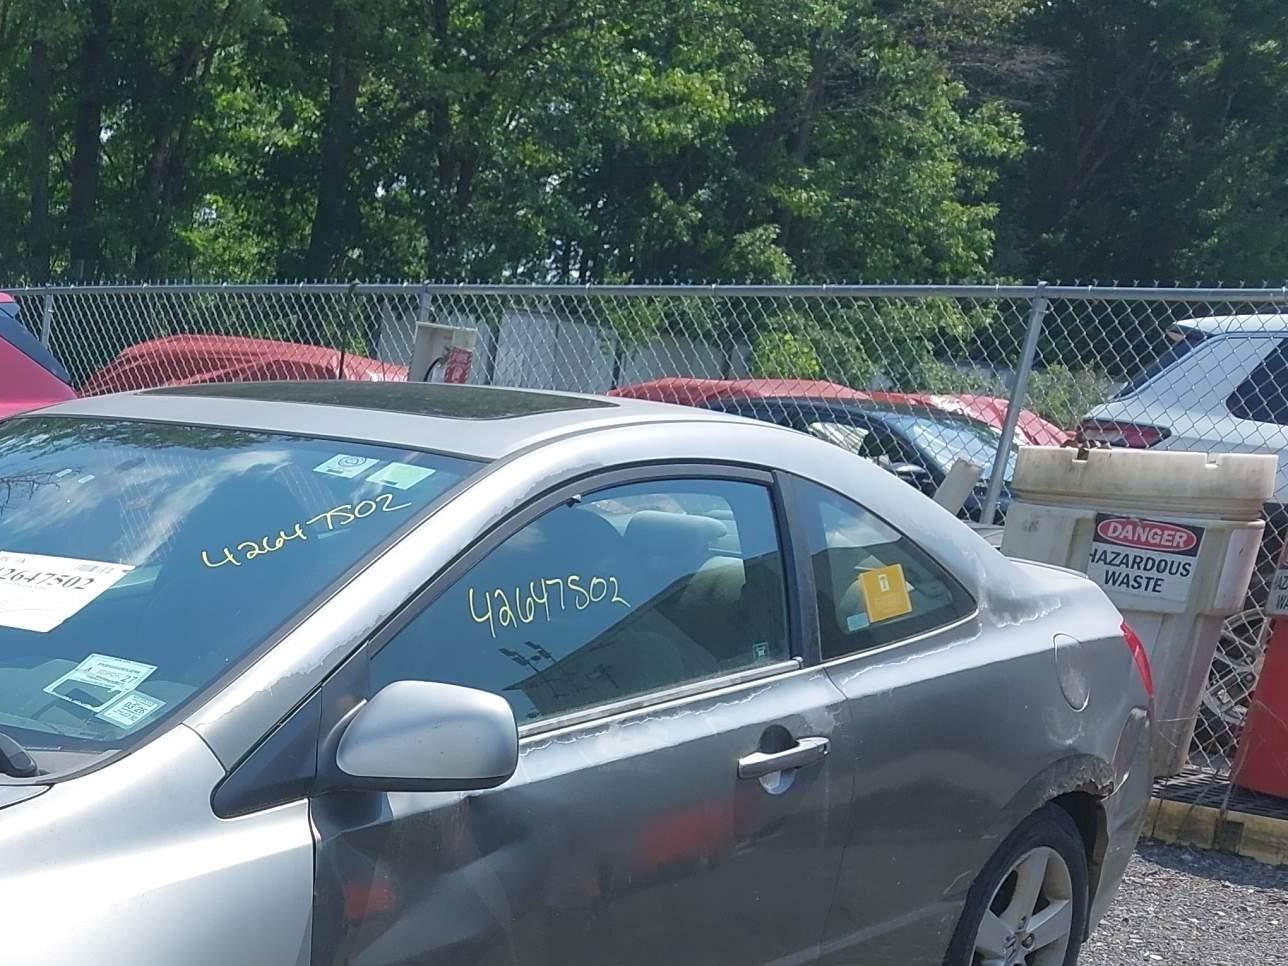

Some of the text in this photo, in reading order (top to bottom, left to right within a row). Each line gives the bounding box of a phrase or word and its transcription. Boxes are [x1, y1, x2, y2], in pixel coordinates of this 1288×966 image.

[201, 493, 413, 568] 42647502
[1107, 521, 1188, 548] DANGER
[1103, 570, 1165, 593] WASTE
[468, 575, 631, 638] 42647502
